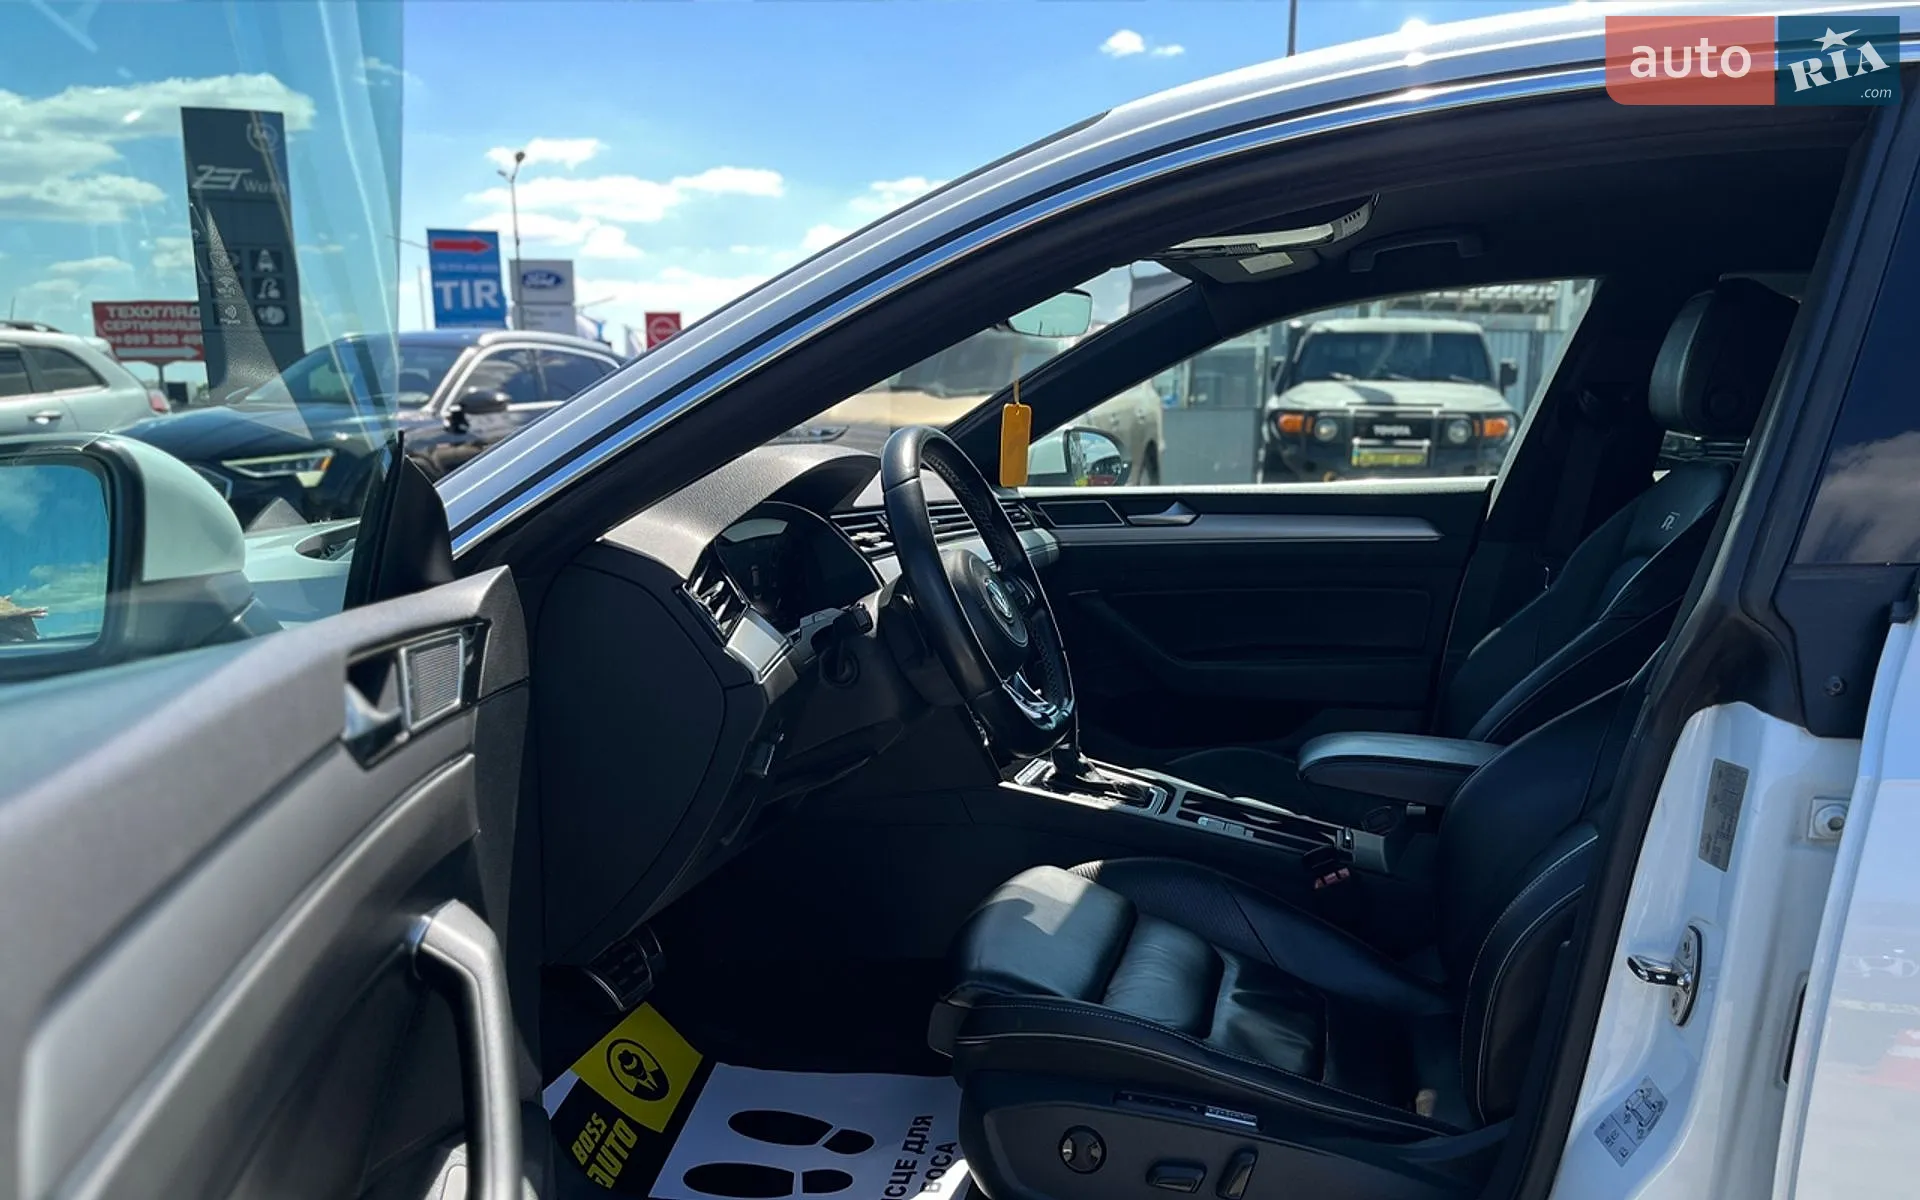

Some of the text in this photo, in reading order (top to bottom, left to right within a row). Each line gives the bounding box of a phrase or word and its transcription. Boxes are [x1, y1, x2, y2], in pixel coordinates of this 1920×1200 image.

[434, 278, 500, 310] TIR
[571, 1111, 607, 1166] BOSS
[881, 1115, 934, 1200] СЦЕ ДЛЯ
